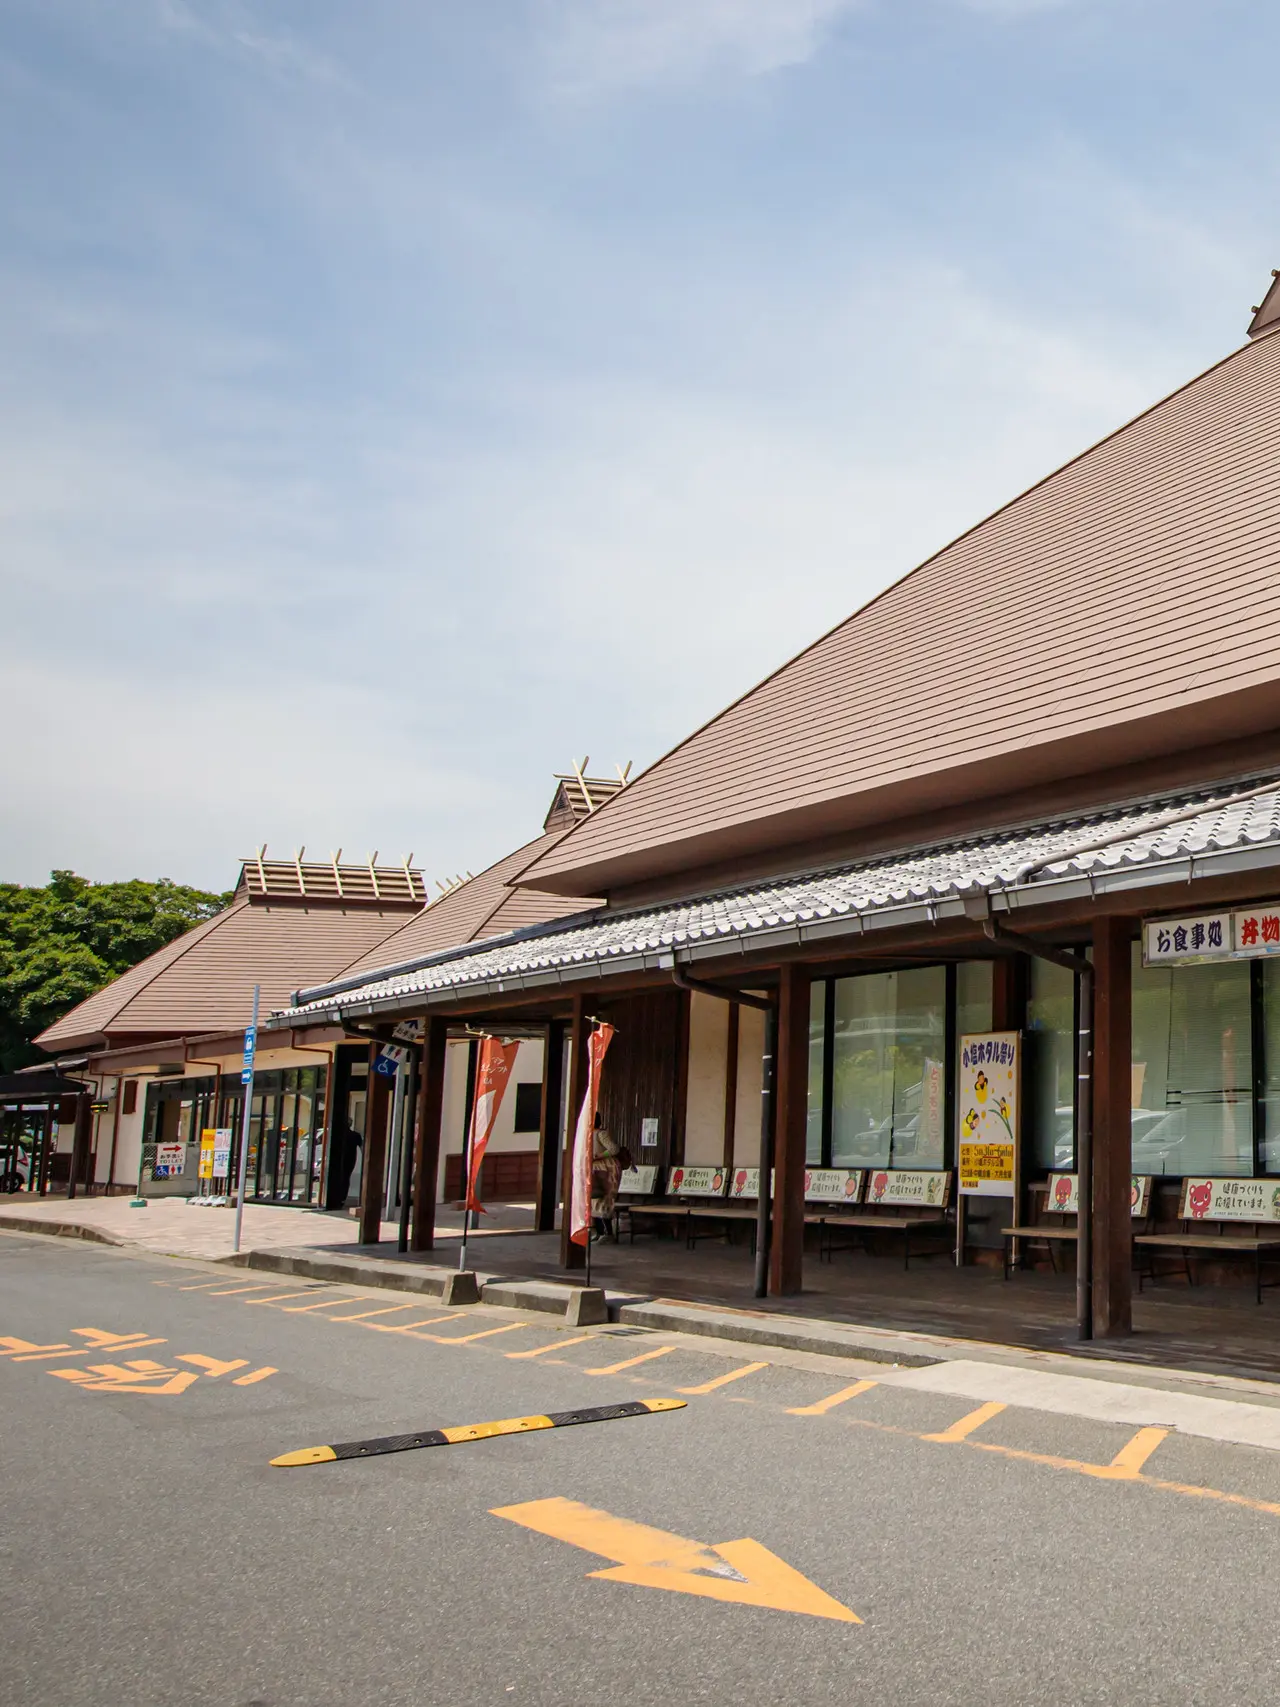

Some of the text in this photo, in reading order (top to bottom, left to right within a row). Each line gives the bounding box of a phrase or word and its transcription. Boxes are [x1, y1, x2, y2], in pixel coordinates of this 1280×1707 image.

[1156, 920, 1223, 954] お食事処
[1222, 1183, 1264, 1195] 健康づくりを
